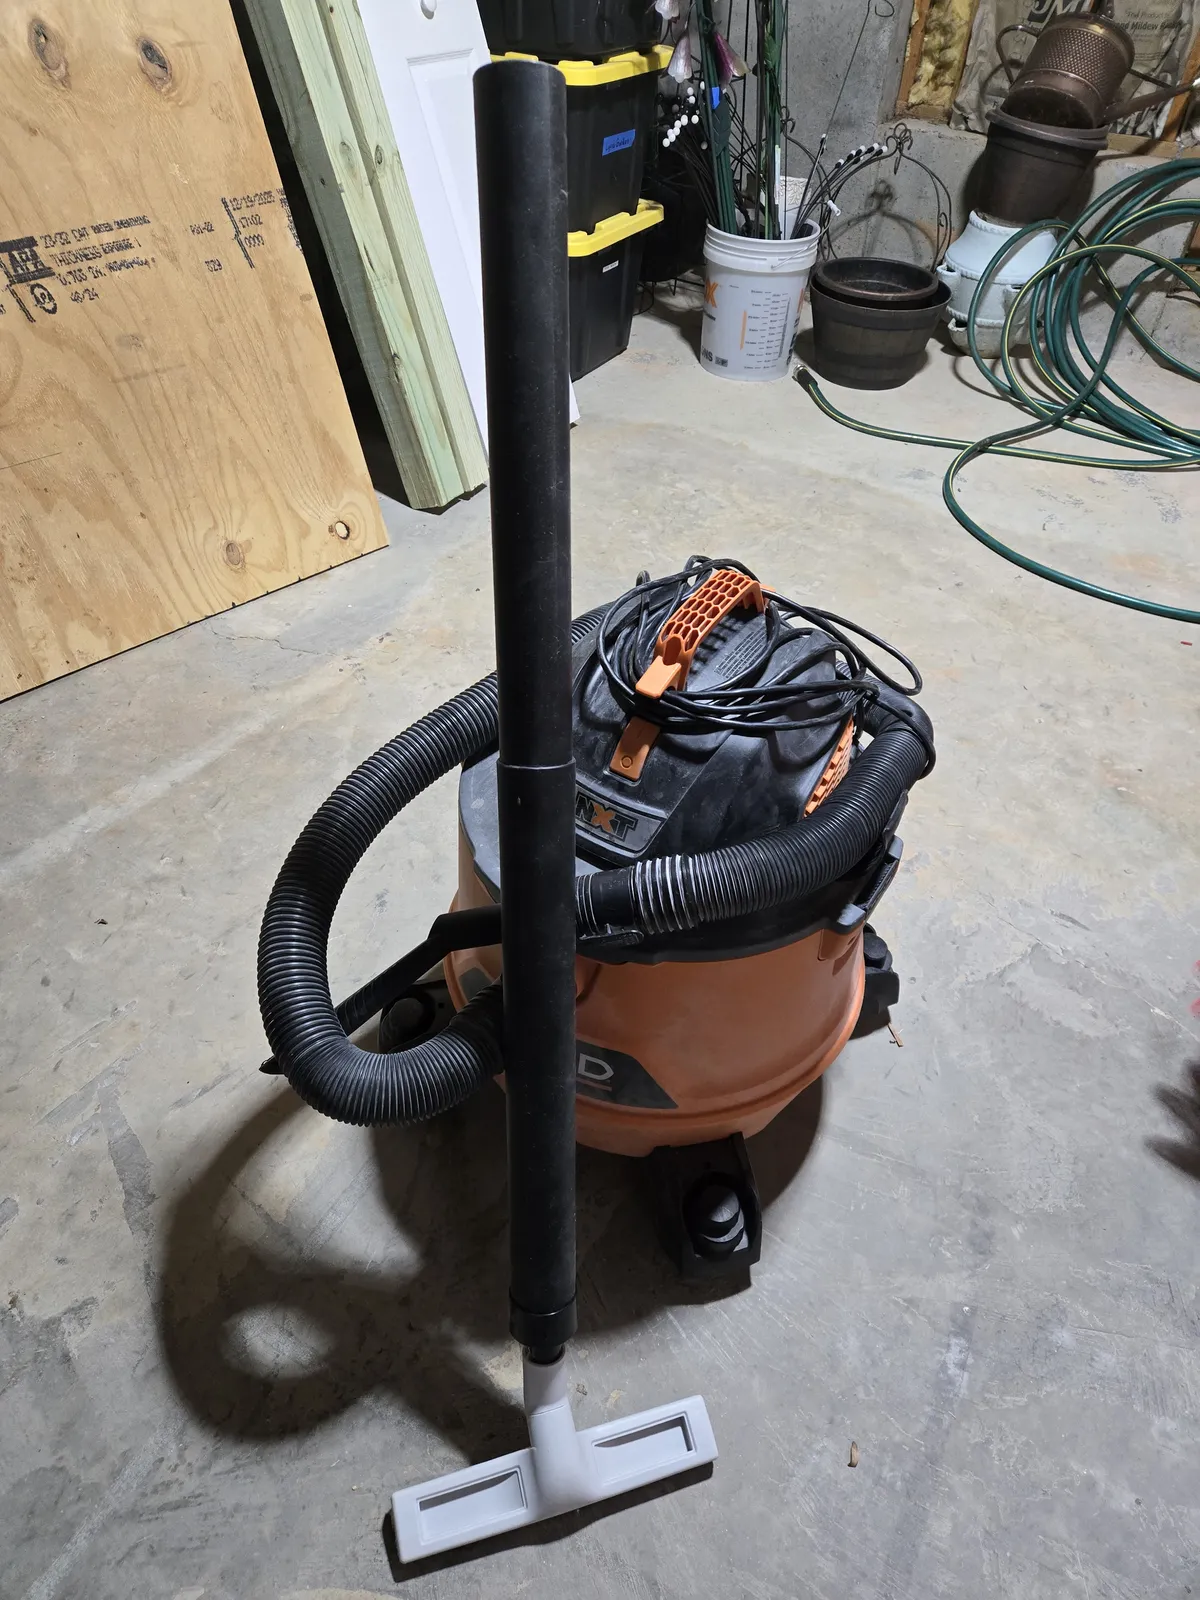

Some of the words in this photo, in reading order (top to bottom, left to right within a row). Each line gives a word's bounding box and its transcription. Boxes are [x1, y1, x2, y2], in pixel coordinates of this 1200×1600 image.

[1131, 21, 1160, 32] Mildew
[49, 246, 102, 267] THICKNESS
[576, 792, 639, 842] NXT
